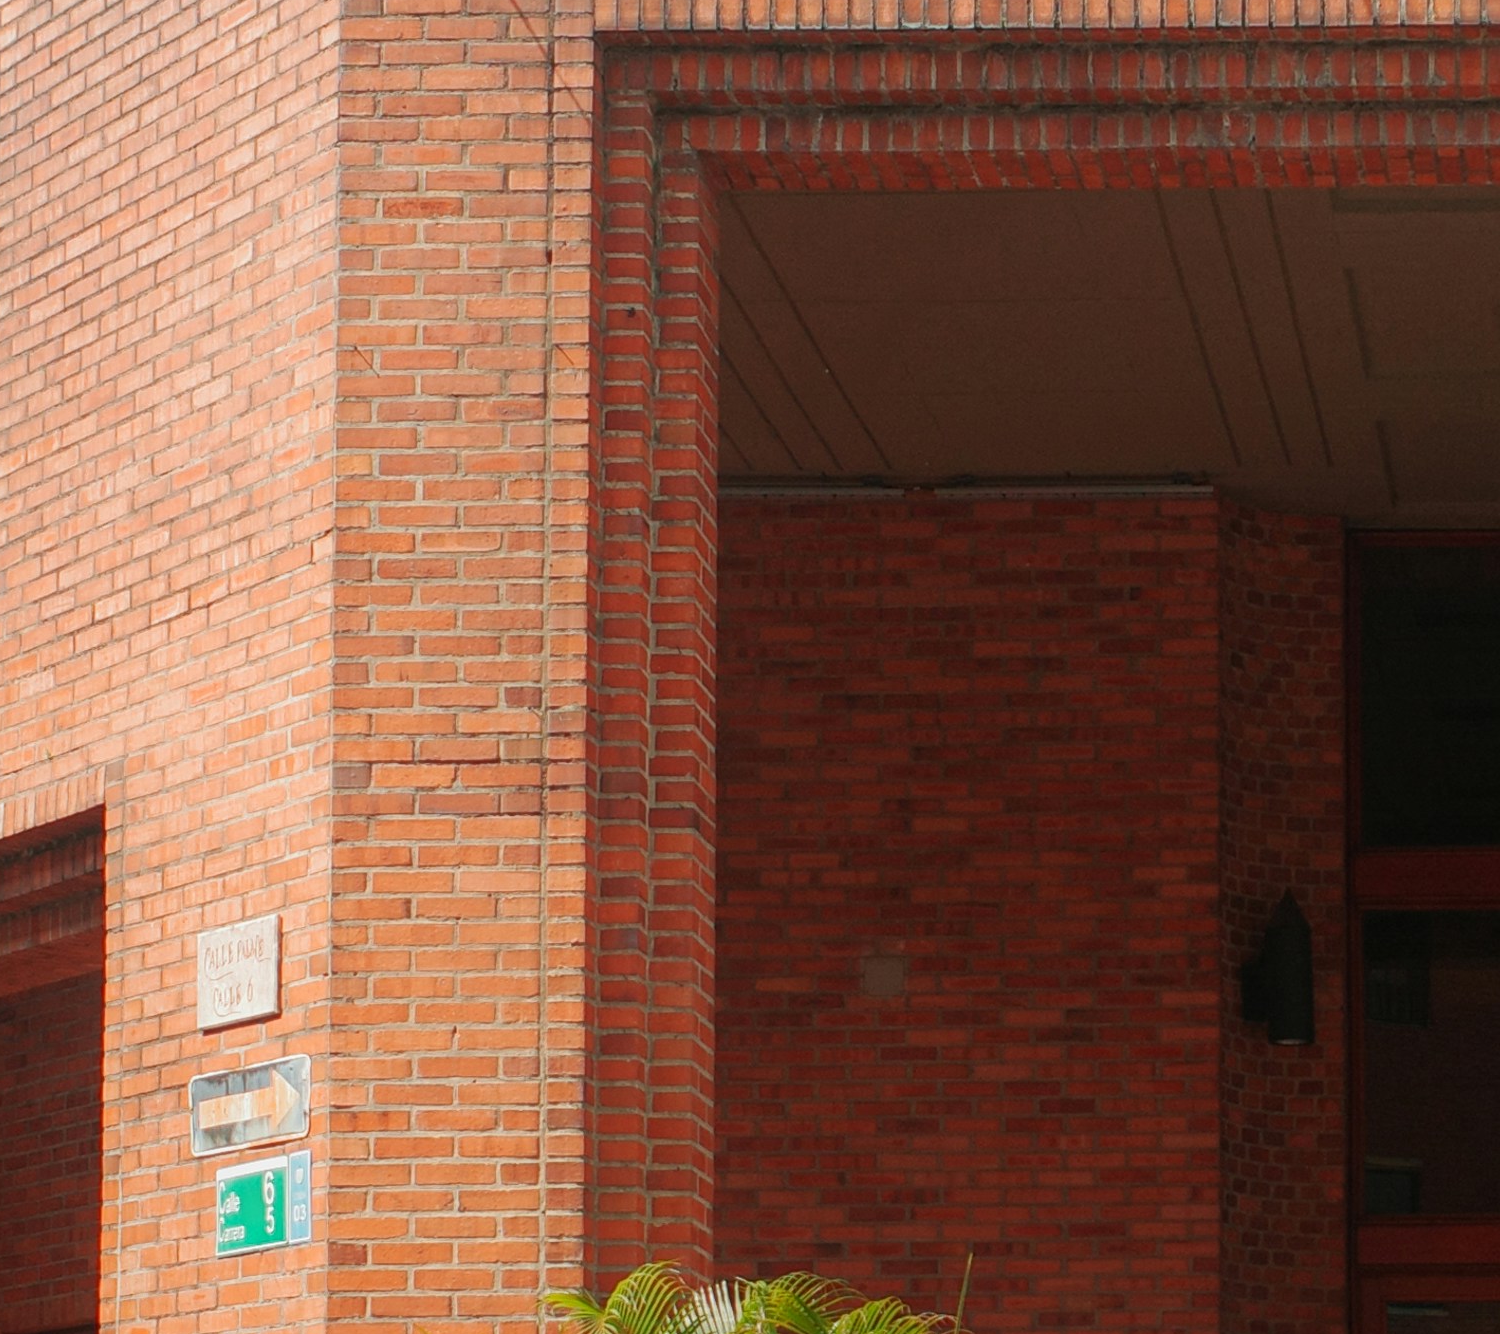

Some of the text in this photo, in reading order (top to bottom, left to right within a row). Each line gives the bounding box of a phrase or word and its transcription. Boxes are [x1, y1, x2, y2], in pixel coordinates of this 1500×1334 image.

[218, 1170, 275, 1215] Calle 6
[265, 1206, 276, 1234] 5
[293, 1203, 307, 1222] 03
